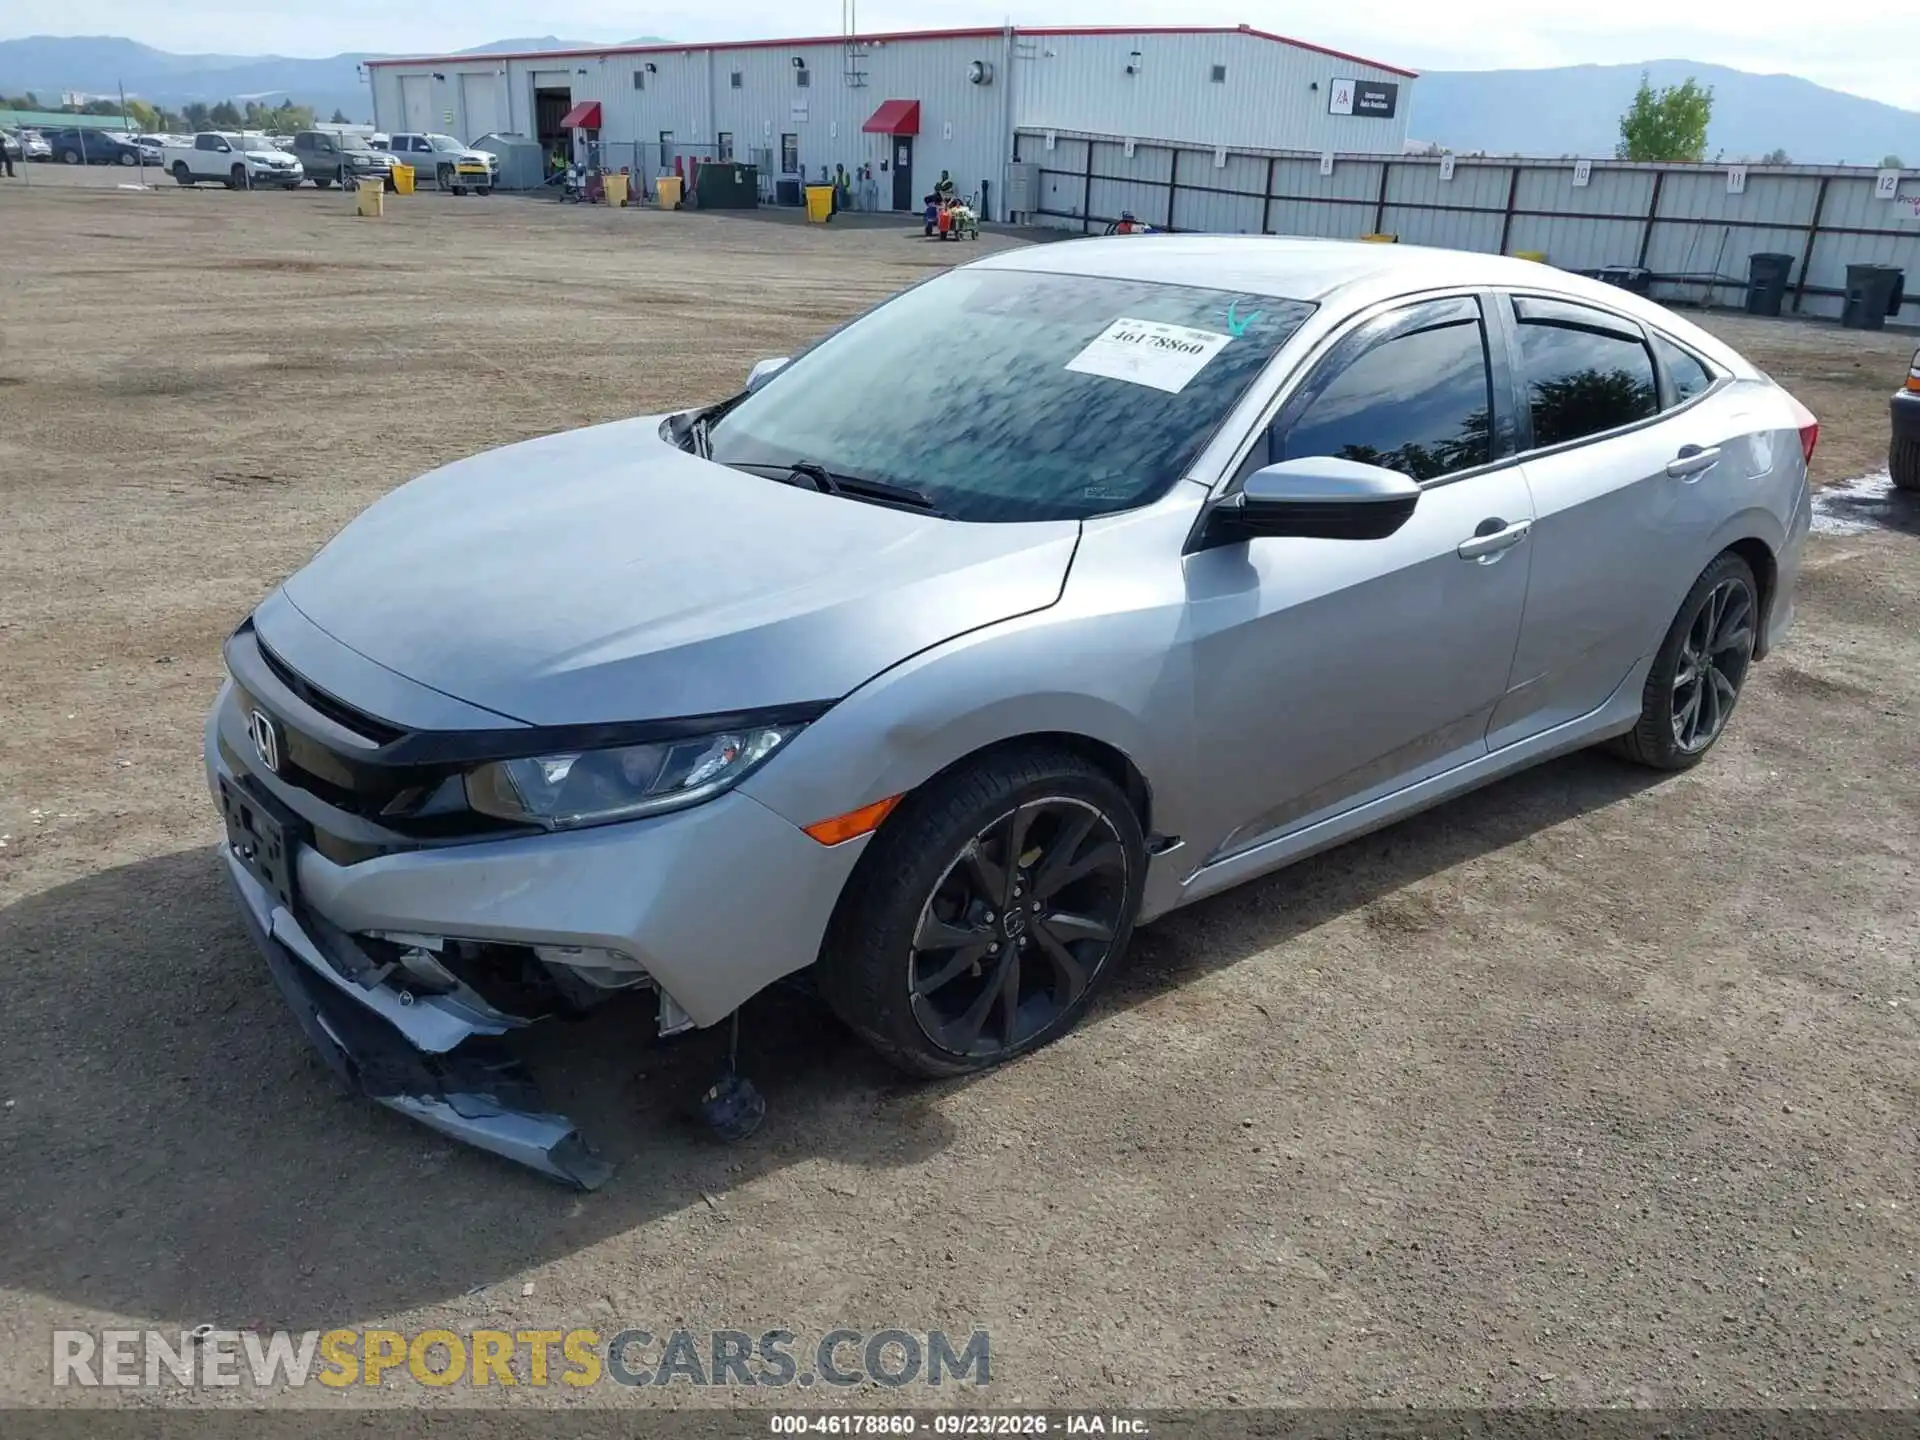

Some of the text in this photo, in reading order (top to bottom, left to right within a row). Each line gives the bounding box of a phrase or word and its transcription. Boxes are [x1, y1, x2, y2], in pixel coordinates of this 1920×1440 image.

[1576, 167, 1587, 179] 10
[1731, 172, 1741, 185] 11
[1880, 177, 1894, 190] 12
[1112, 330, 1204, 355] 46178860
